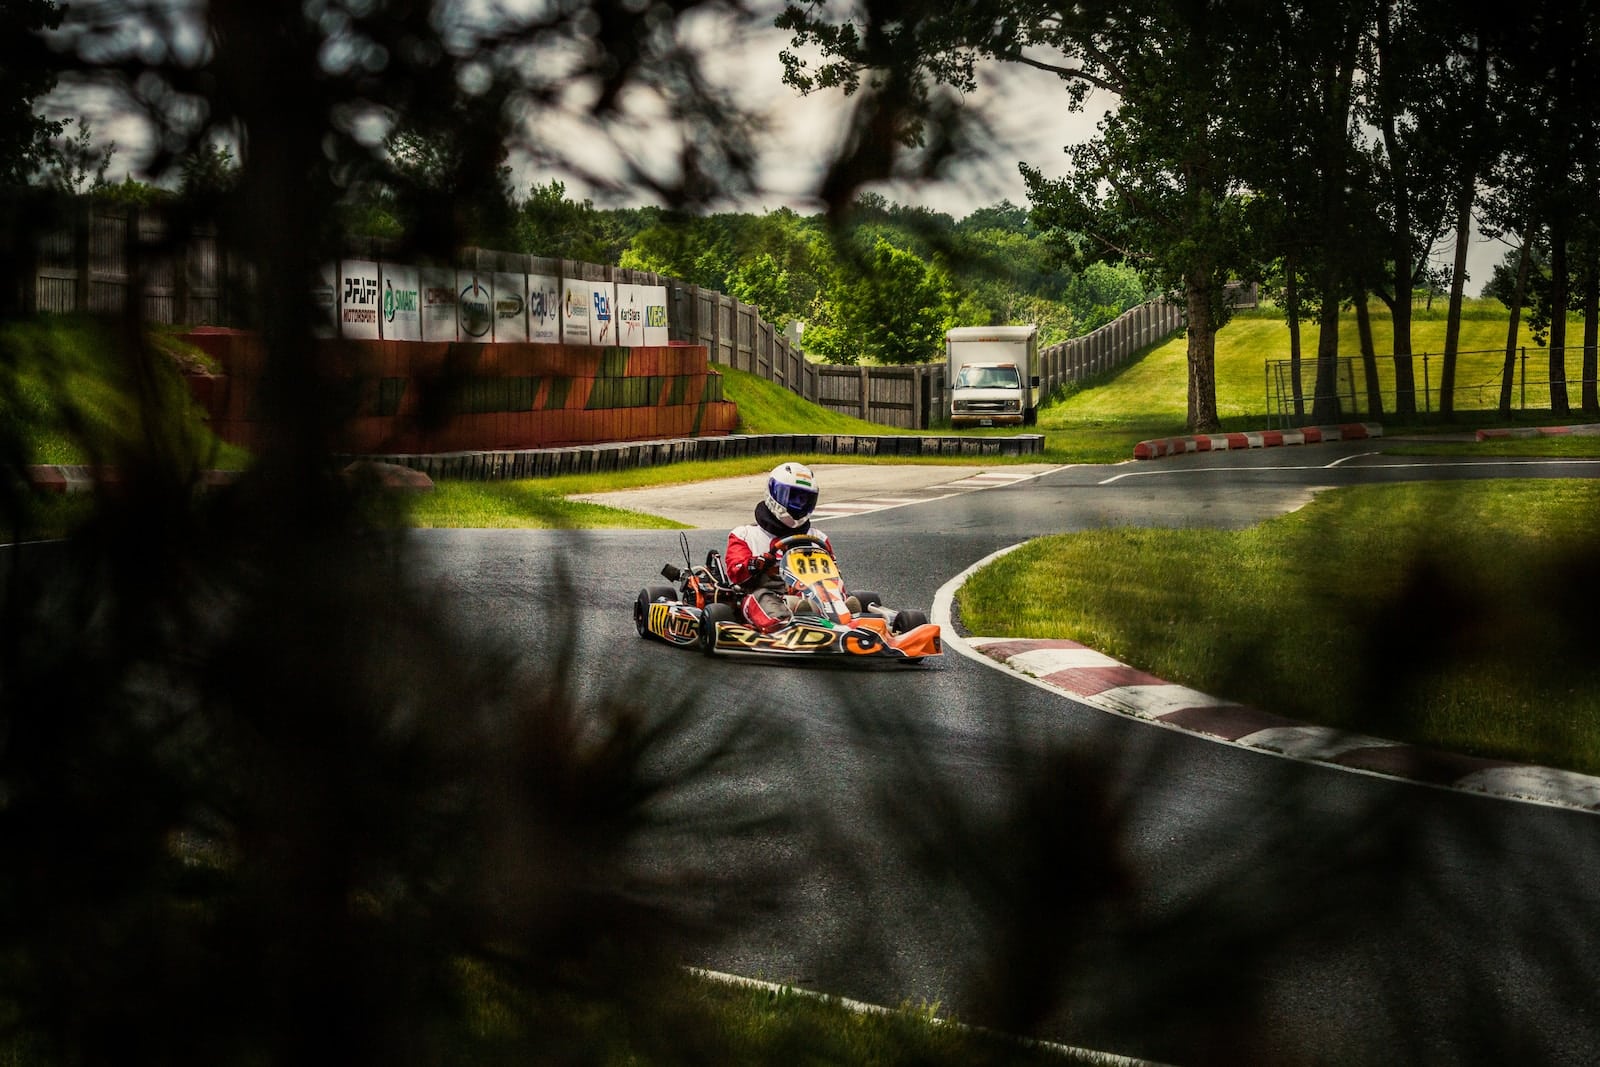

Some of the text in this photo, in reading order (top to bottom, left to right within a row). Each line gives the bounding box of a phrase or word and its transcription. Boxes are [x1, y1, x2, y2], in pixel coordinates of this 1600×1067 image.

[344, 277, 377, 304] PFAFF
[395, 289, 417, 311] SMART
[647, 305, 667, 327] VEGA
